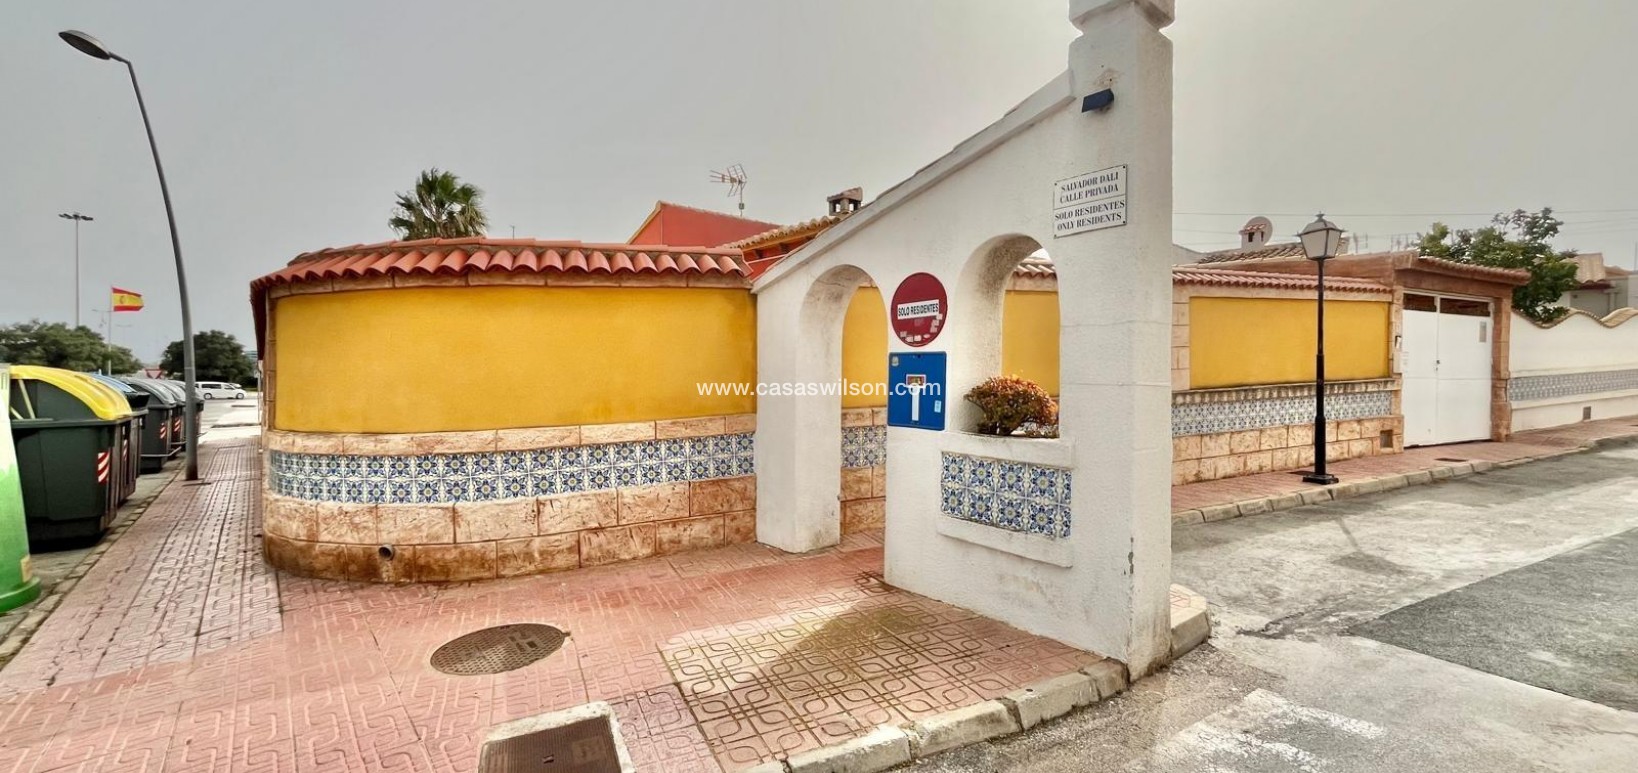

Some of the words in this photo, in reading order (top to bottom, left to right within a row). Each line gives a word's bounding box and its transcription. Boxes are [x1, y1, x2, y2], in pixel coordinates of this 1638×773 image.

[1061, 177, 1098, 191] SALVADOR
[1100, 172, 1118, 183] DALI
[1060, 192, 1083, 203] CALLE
[1085, 184, 1118, 198] PRIVADA
[1055, 211, 1073, 220] SOLO
[1075, 200, 1125, 217] RESIDENTES
[1057, 221, 1074, 231] ONLY
[1076, 212, 1122, 228] RESIDENTS
[898, 306, 910, 316] SOLO
[910, 303, 939, 315] RESIDENTES
